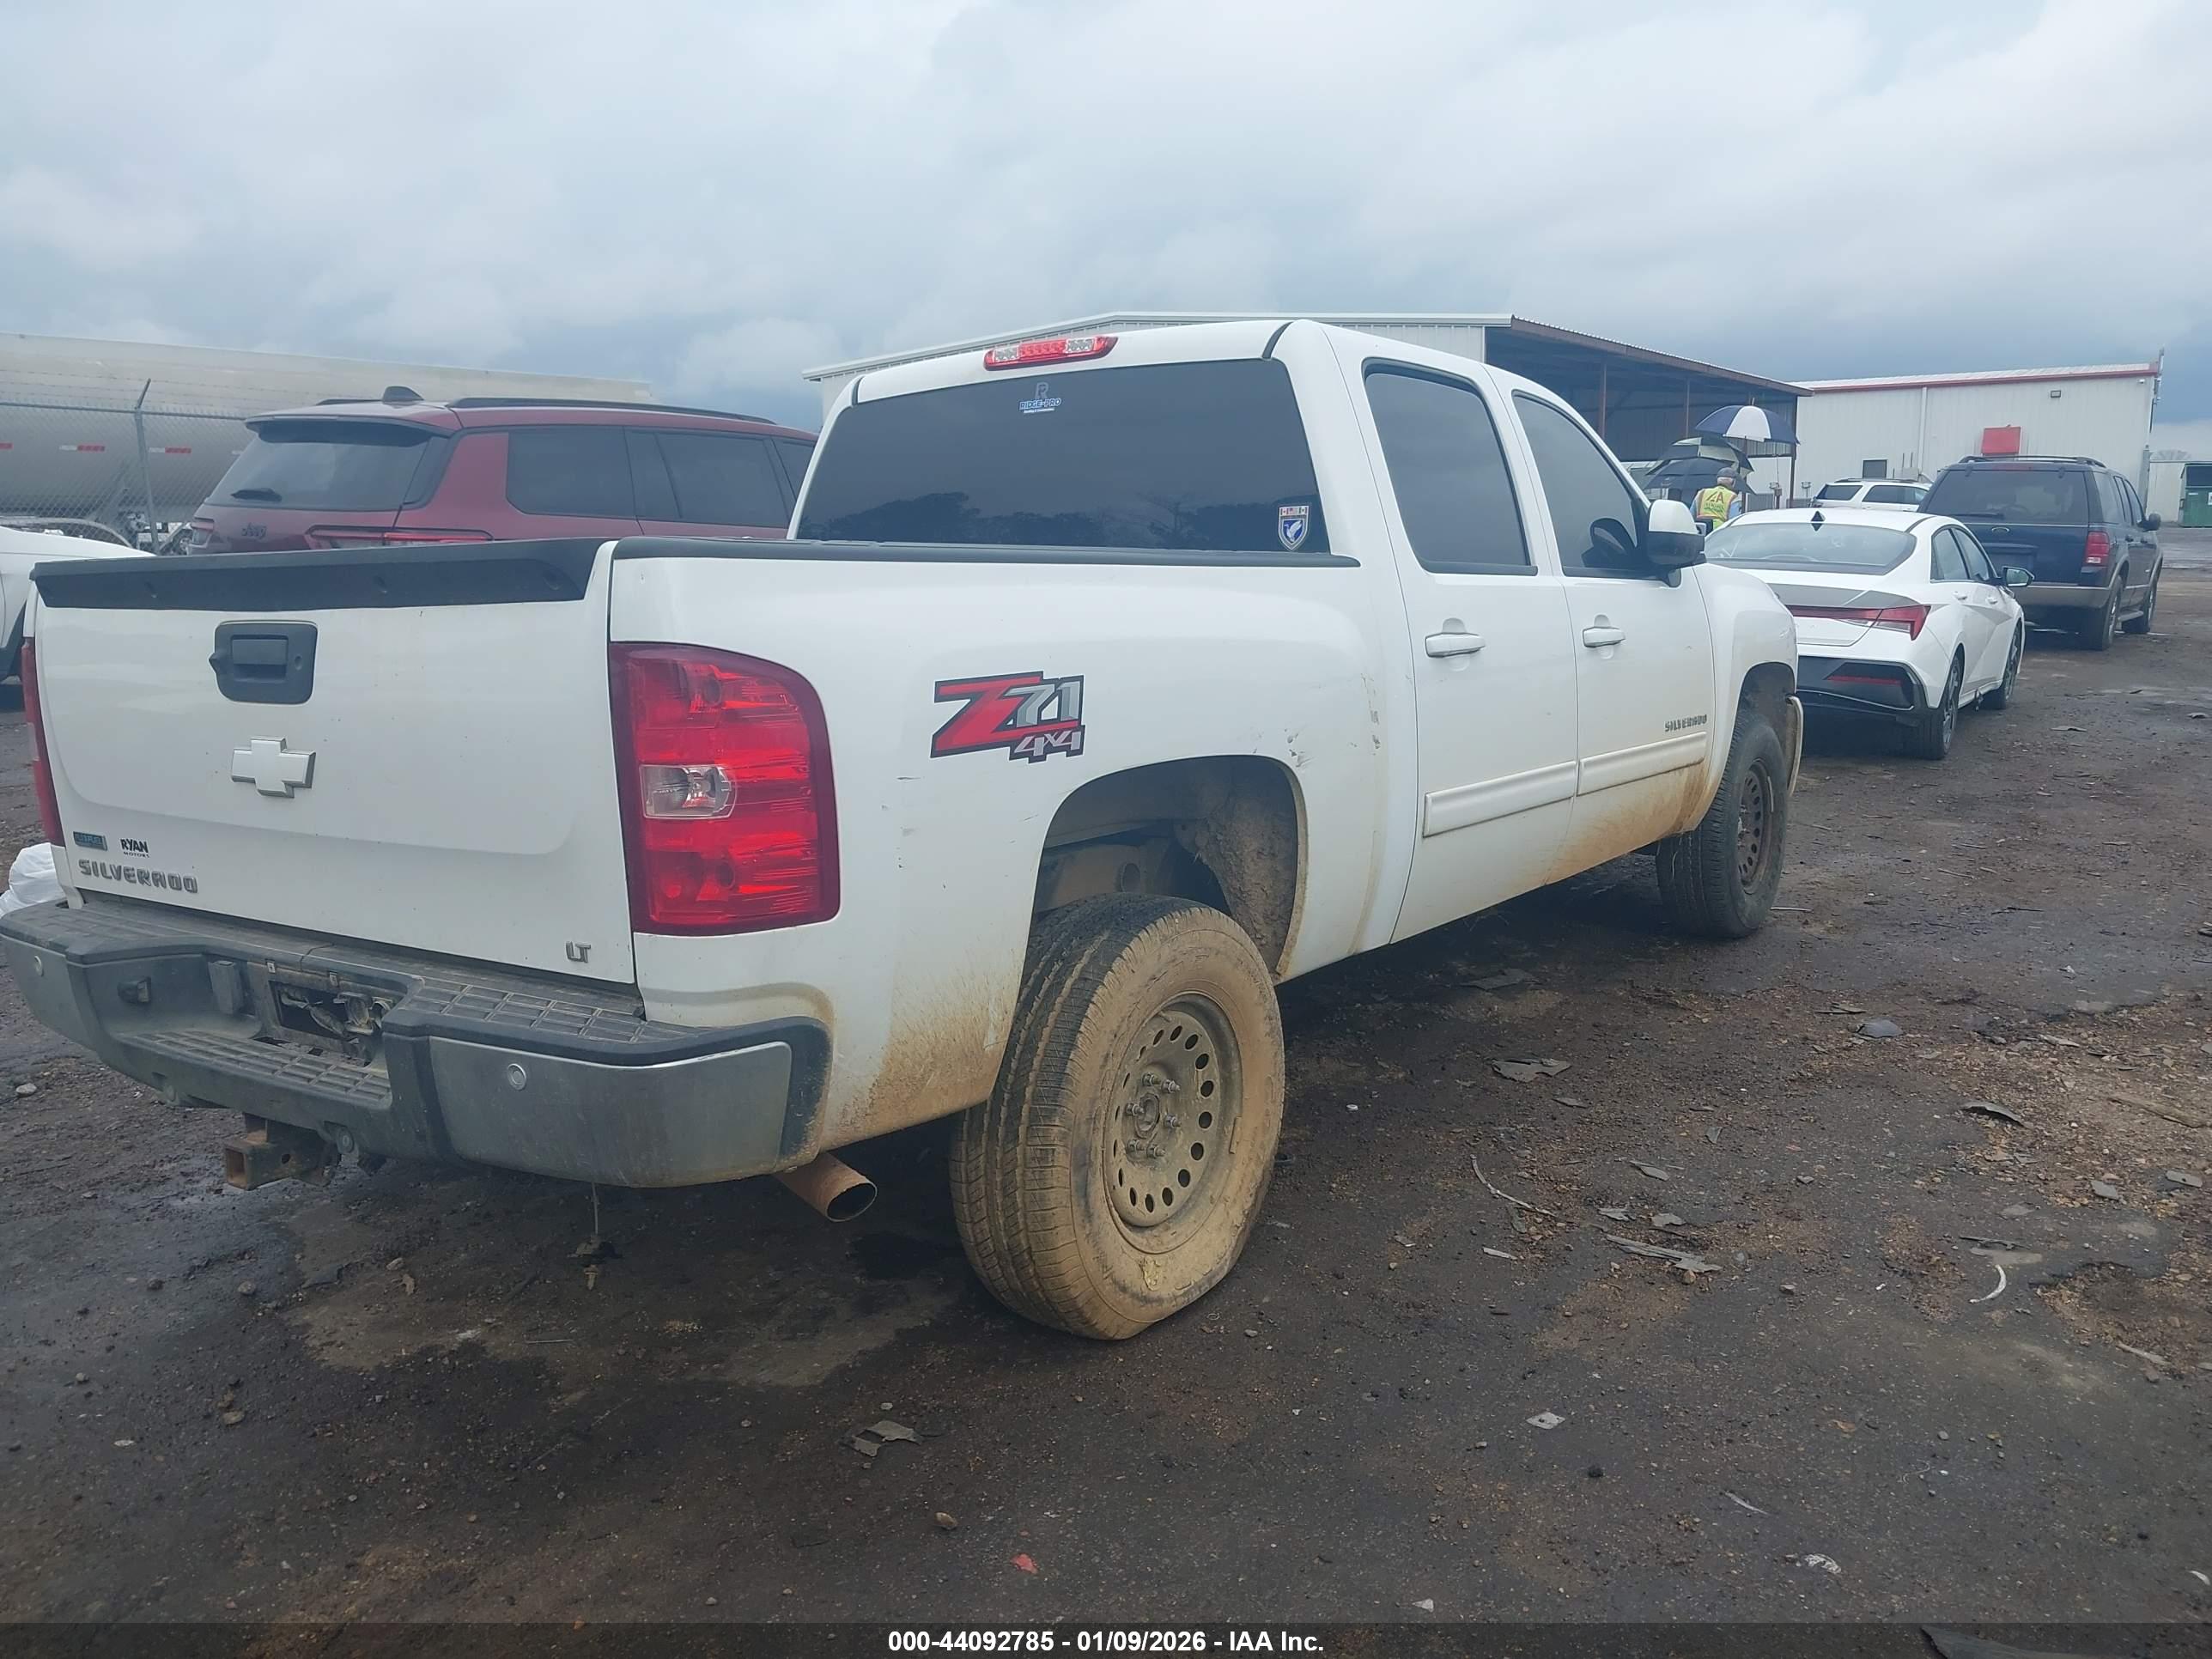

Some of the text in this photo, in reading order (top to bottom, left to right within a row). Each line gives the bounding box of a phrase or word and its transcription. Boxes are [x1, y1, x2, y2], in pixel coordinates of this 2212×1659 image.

[930, 671, 1085, 758] Z71
[1664, 714, 1707, 732] SILVERADO
[120, 838, 149, 853] RYAN
[79, 859, 198, 894] SILVERADO
[565, 941, 592, 963] LT
